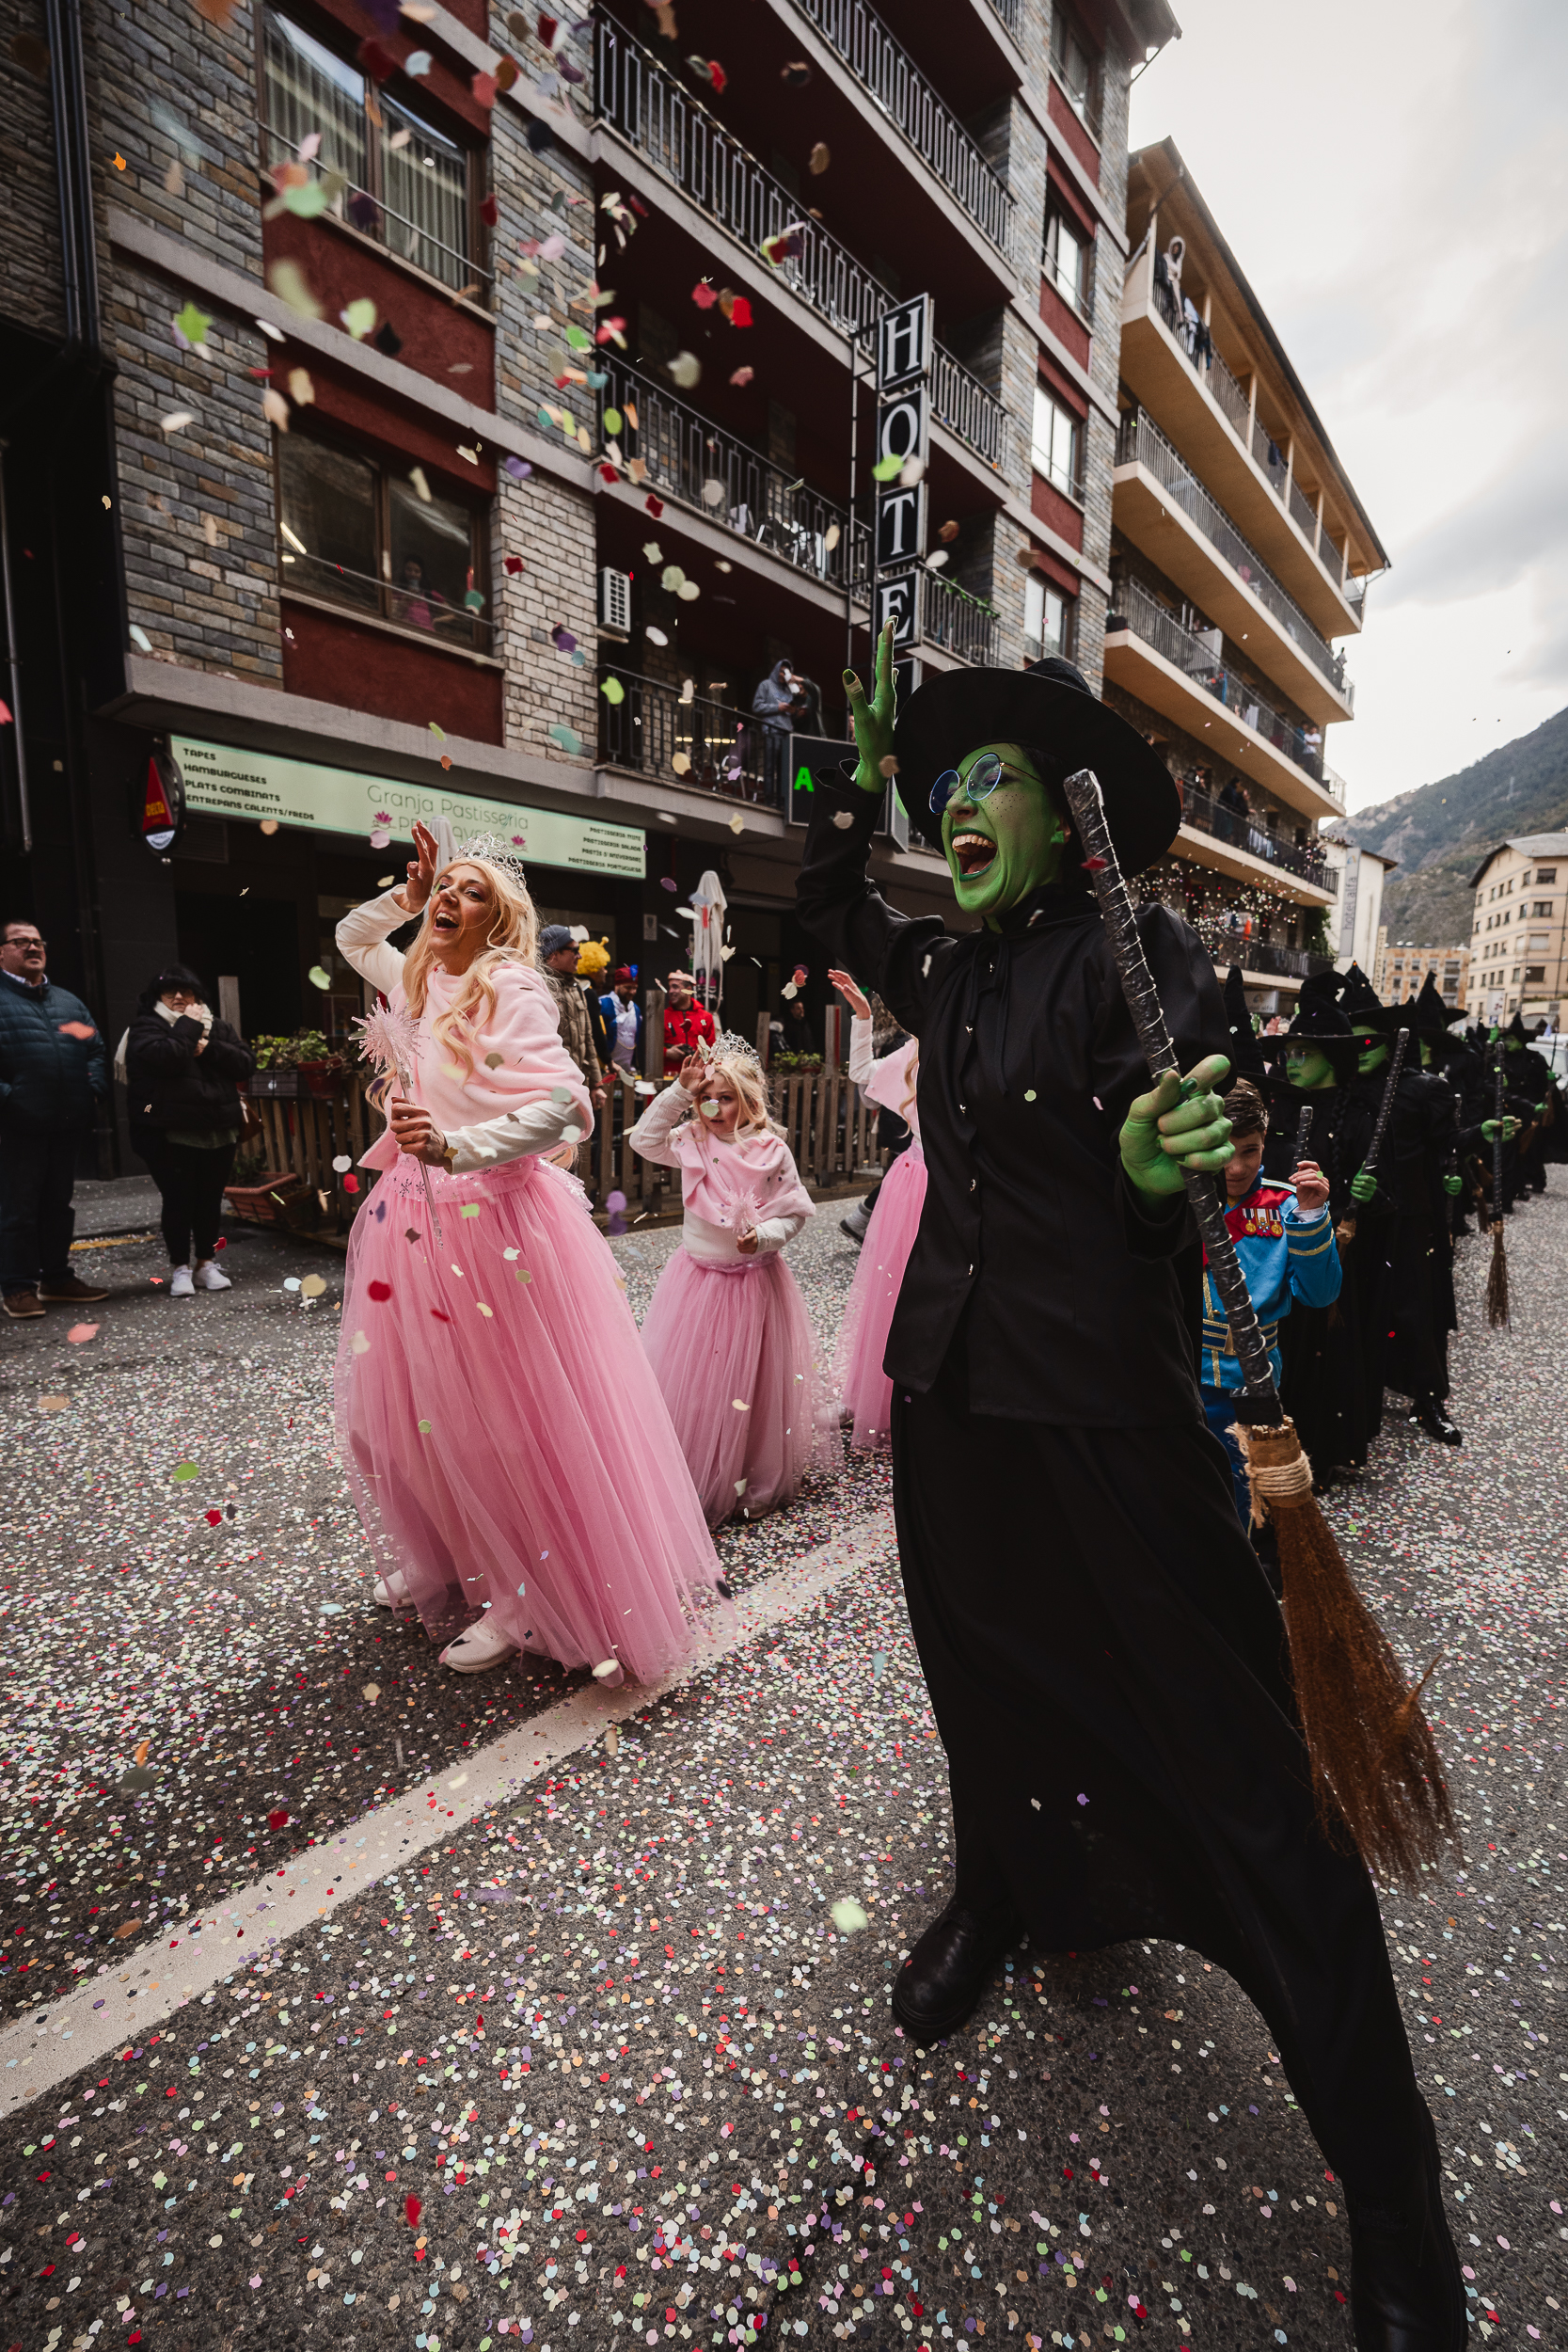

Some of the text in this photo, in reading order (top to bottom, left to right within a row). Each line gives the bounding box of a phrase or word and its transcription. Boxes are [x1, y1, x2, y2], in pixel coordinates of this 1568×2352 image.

[879, 304, 921, 642] HOTE
[182, 747, 216, 761] TAPES
[183, 763, 267, 785] HAMBURGUESES
[184, 779, 281, 803] PLATS COMBINATS
[185, 793, 243, 810] ENTREPANS
[367, 785, 529, 830] Granja Pastisseria
[1342, 876, 1357, 930] hotel alfa
